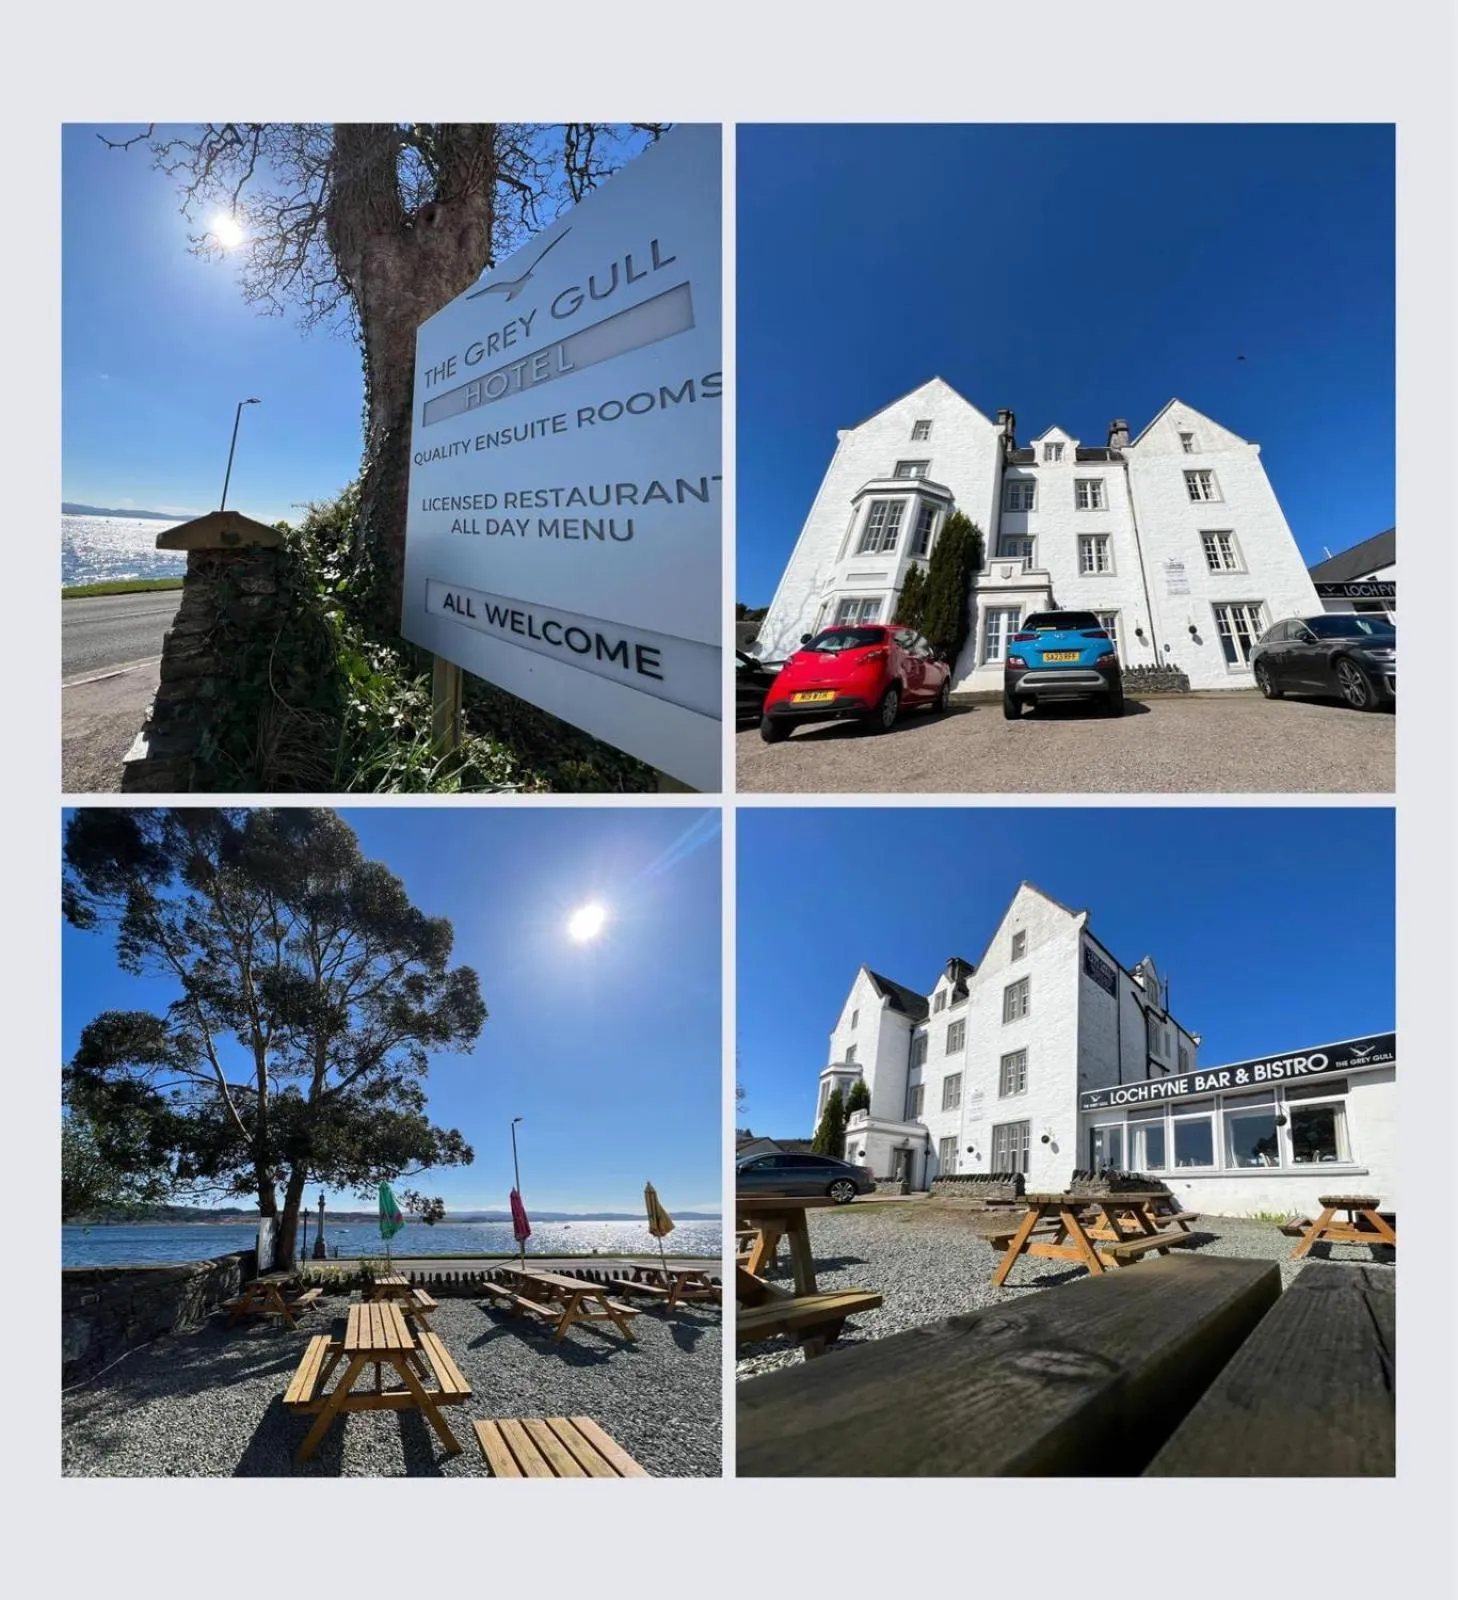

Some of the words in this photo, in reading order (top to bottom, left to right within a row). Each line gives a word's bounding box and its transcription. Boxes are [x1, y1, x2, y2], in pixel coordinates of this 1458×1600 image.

[424, 356, 457, 389] THE
[464, 308, 537, 367] GREY
[551, 239, 677, 319] GULL
[464, 345, 576, 411] HOTEL
[413, 439, 472, 466] QUALITY
[475, 413, 568, 452] ENSUITE
[577, 371, 722, 428] ROOMS
[422, 493, 498, 512] LICENSED
[451, 519, 480, 535] ALL
[486, 519, 530, 536] DAY
[538, 518, 635, 542] MENU
[442, 592, 477, 619] ALL
[485, 602, 664, 681] WELCOME
[1110, 1086, 1148, 1105] LOCH
[1150, 1079, 1189, 1099] FYNE
[1194, 1071, 1231, 1091] BAR
[1235, 1068, 1249, 1085] &
[1254, 1053, 1329, 1082] BISTRO
